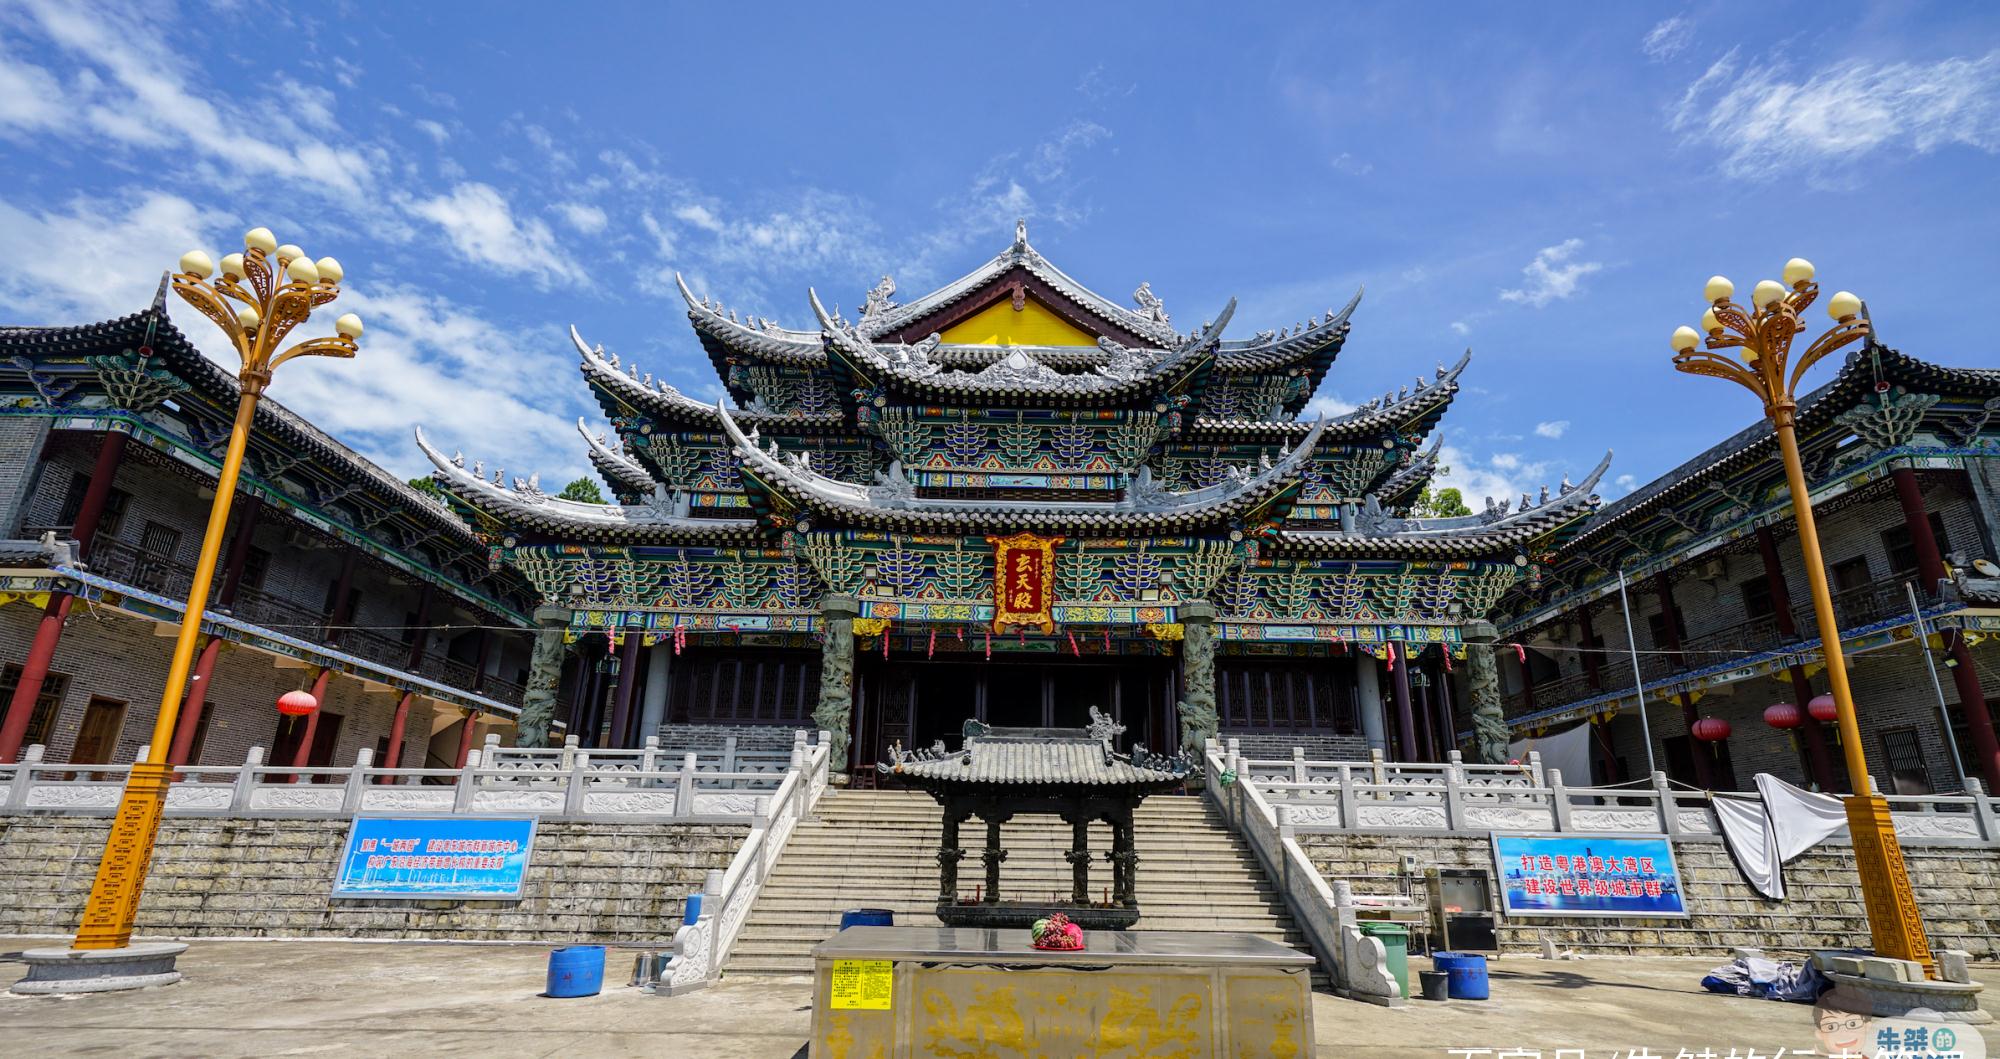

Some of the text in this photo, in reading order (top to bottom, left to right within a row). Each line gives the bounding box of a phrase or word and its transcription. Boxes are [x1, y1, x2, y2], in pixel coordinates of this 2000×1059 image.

[1014, 553, 1034, 609] 玄天殿
[1521, 855, 1656, 873] 打造粤港澳大湾区
[1525, 879, 1662, 897] 建设世界级城市群
